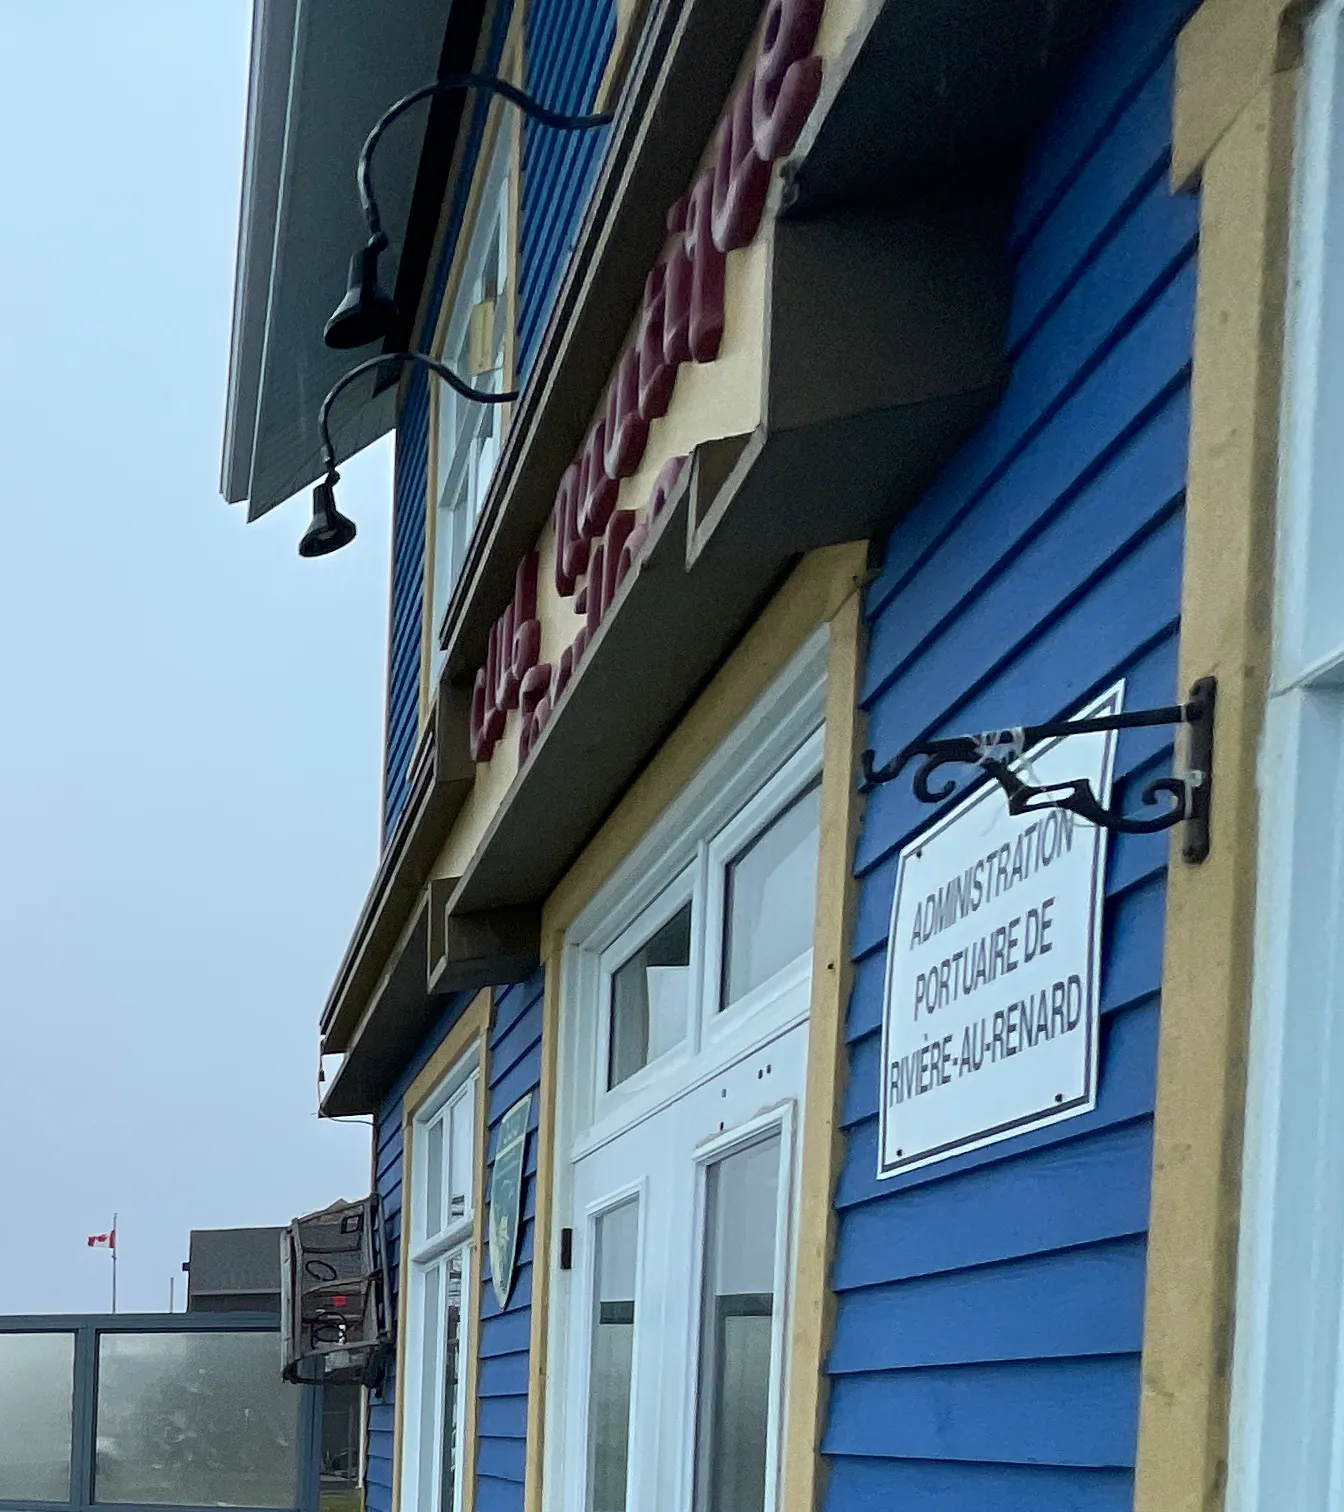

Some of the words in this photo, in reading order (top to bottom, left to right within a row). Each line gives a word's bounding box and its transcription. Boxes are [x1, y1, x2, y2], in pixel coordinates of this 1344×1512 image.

[910, 808, 1074, 950] ADMINISTRATION
[914, 916, 1020, 1021] PORTUAIRE
[1024, 896, 1055, 963] DE
[889, 974, 1082, 1107] RIVIÈRE-AU-RENARD
